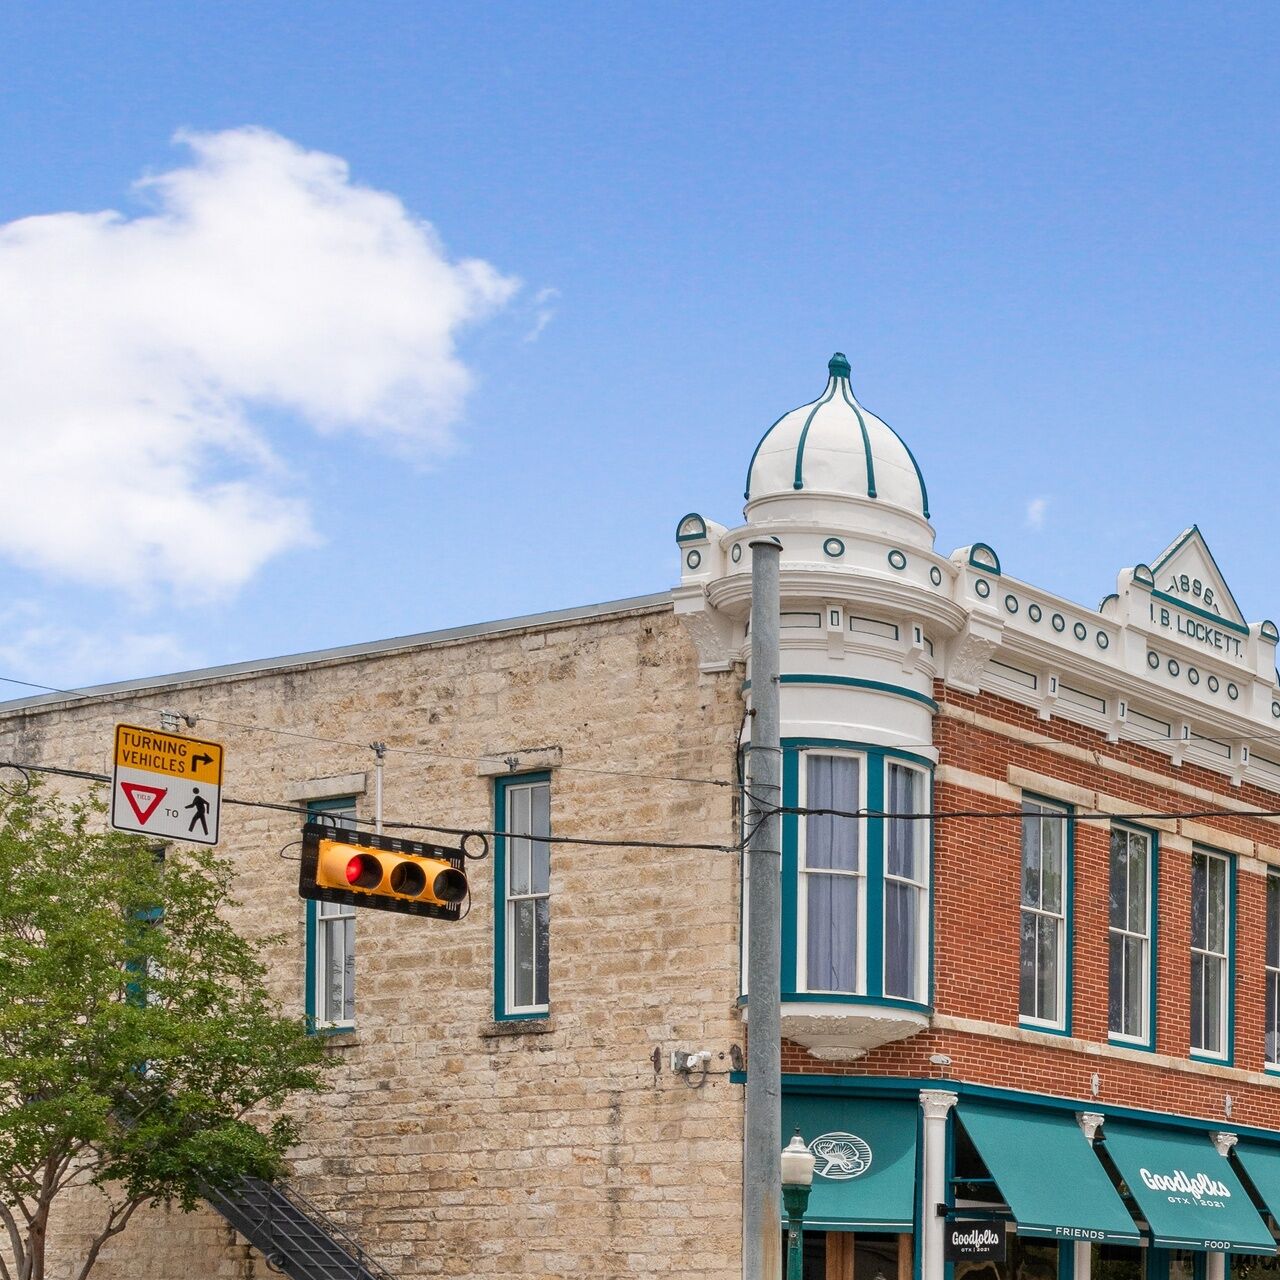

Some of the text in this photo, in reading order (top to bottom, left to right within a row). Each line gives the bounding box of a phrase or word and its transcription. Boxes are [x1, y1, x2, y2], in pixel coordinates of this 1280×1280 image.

[1173, 574, 1214, 606] 1896
[1161, 608, 1173, 630] B.
[122, 732, 187, 757] TURNING
[122, 749, 185, 773] VEHICLES
[136, 793, 152, 801] YIELD
[165, 808, 179, 818] TO
[1139, 1168, 1231, 1200] Goodfolks
[1167, 1196, 1191, 1204] GTX
[1200, 1200, 1225, 1208] 2021
[952, 1230, 999, 1248] Goodfolks
[1056, 1227, 1105, 1240] FRIENDS
[1204, 1241, 1230, 1250] FOOD
